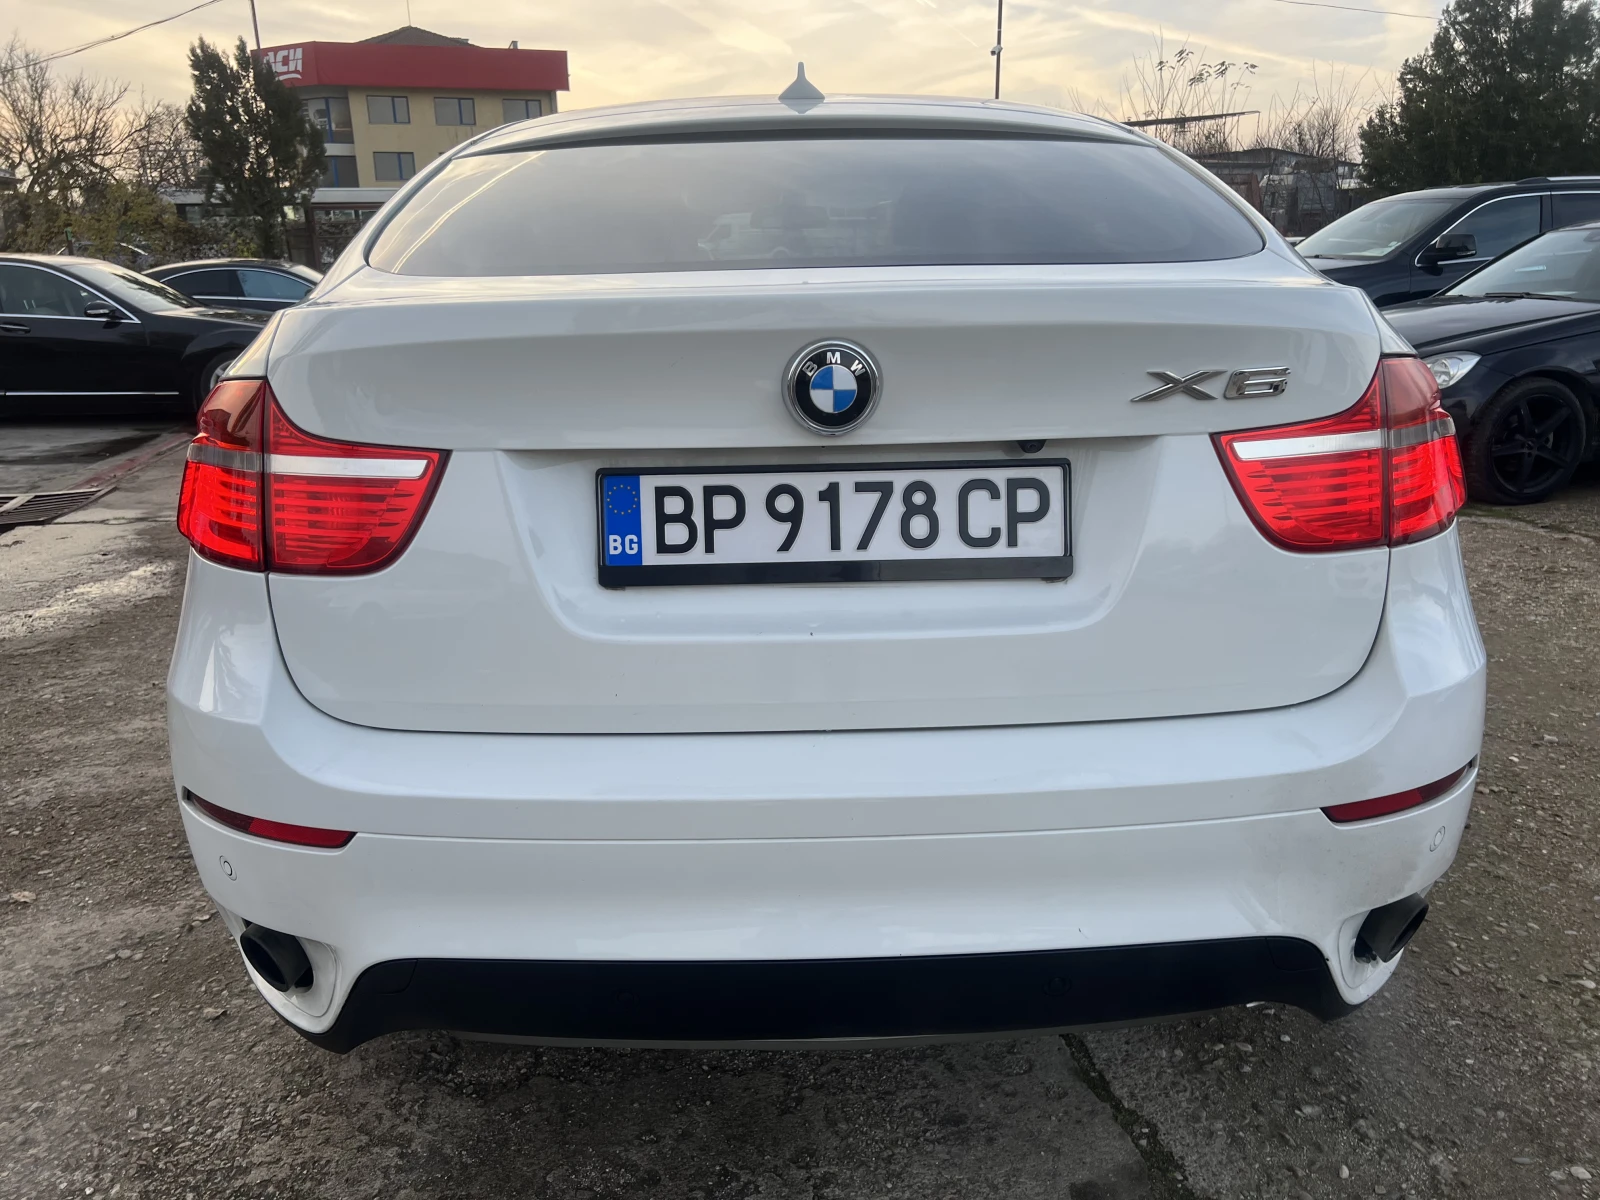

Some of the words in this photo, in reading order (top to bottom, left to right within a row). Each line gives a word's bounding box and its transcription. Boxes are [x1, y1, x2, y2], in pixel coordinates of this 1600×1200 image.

[802, 351, 866, 377] BMW
[1130, 366, 1292, 402] X6
[654, 485, 747, 554] BP
[765, 480, 939, 553] 9178
[957, 477, 1052, 549] CP
[608, 534, 639, 555] BG
